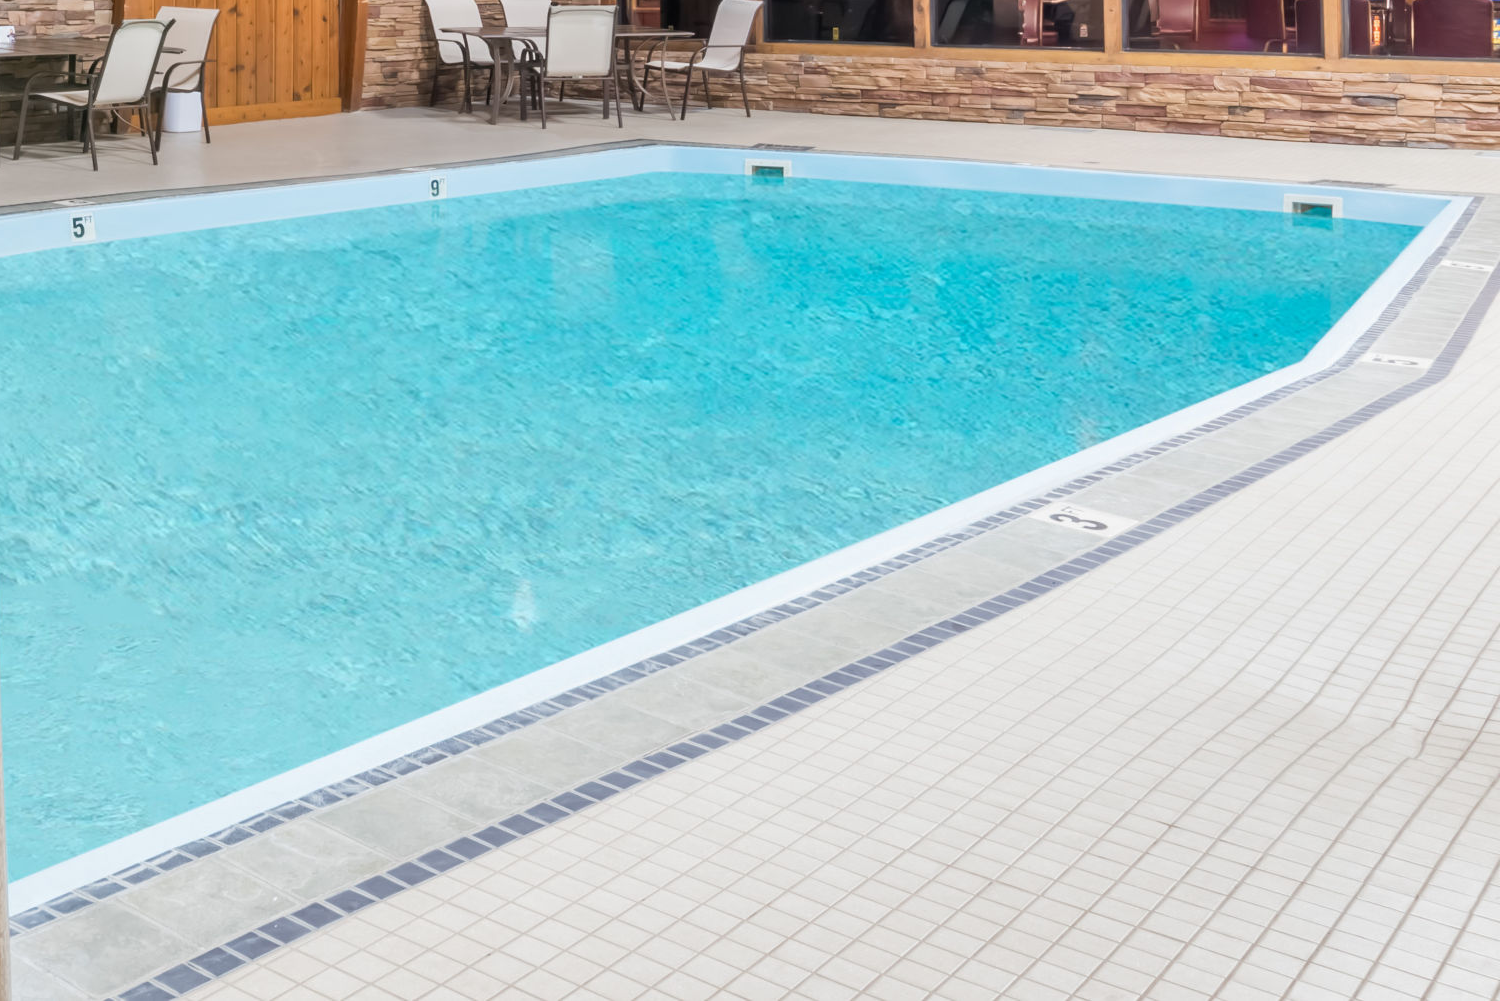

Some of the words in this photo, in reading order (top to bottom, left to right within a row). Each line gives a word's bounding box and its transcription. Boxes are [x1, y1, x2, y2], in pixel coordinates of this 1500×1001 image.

[431, 179, 440, 197] 9
[72, 216, 85, 238] 5
[1049, 513, 1108, 531] 3
